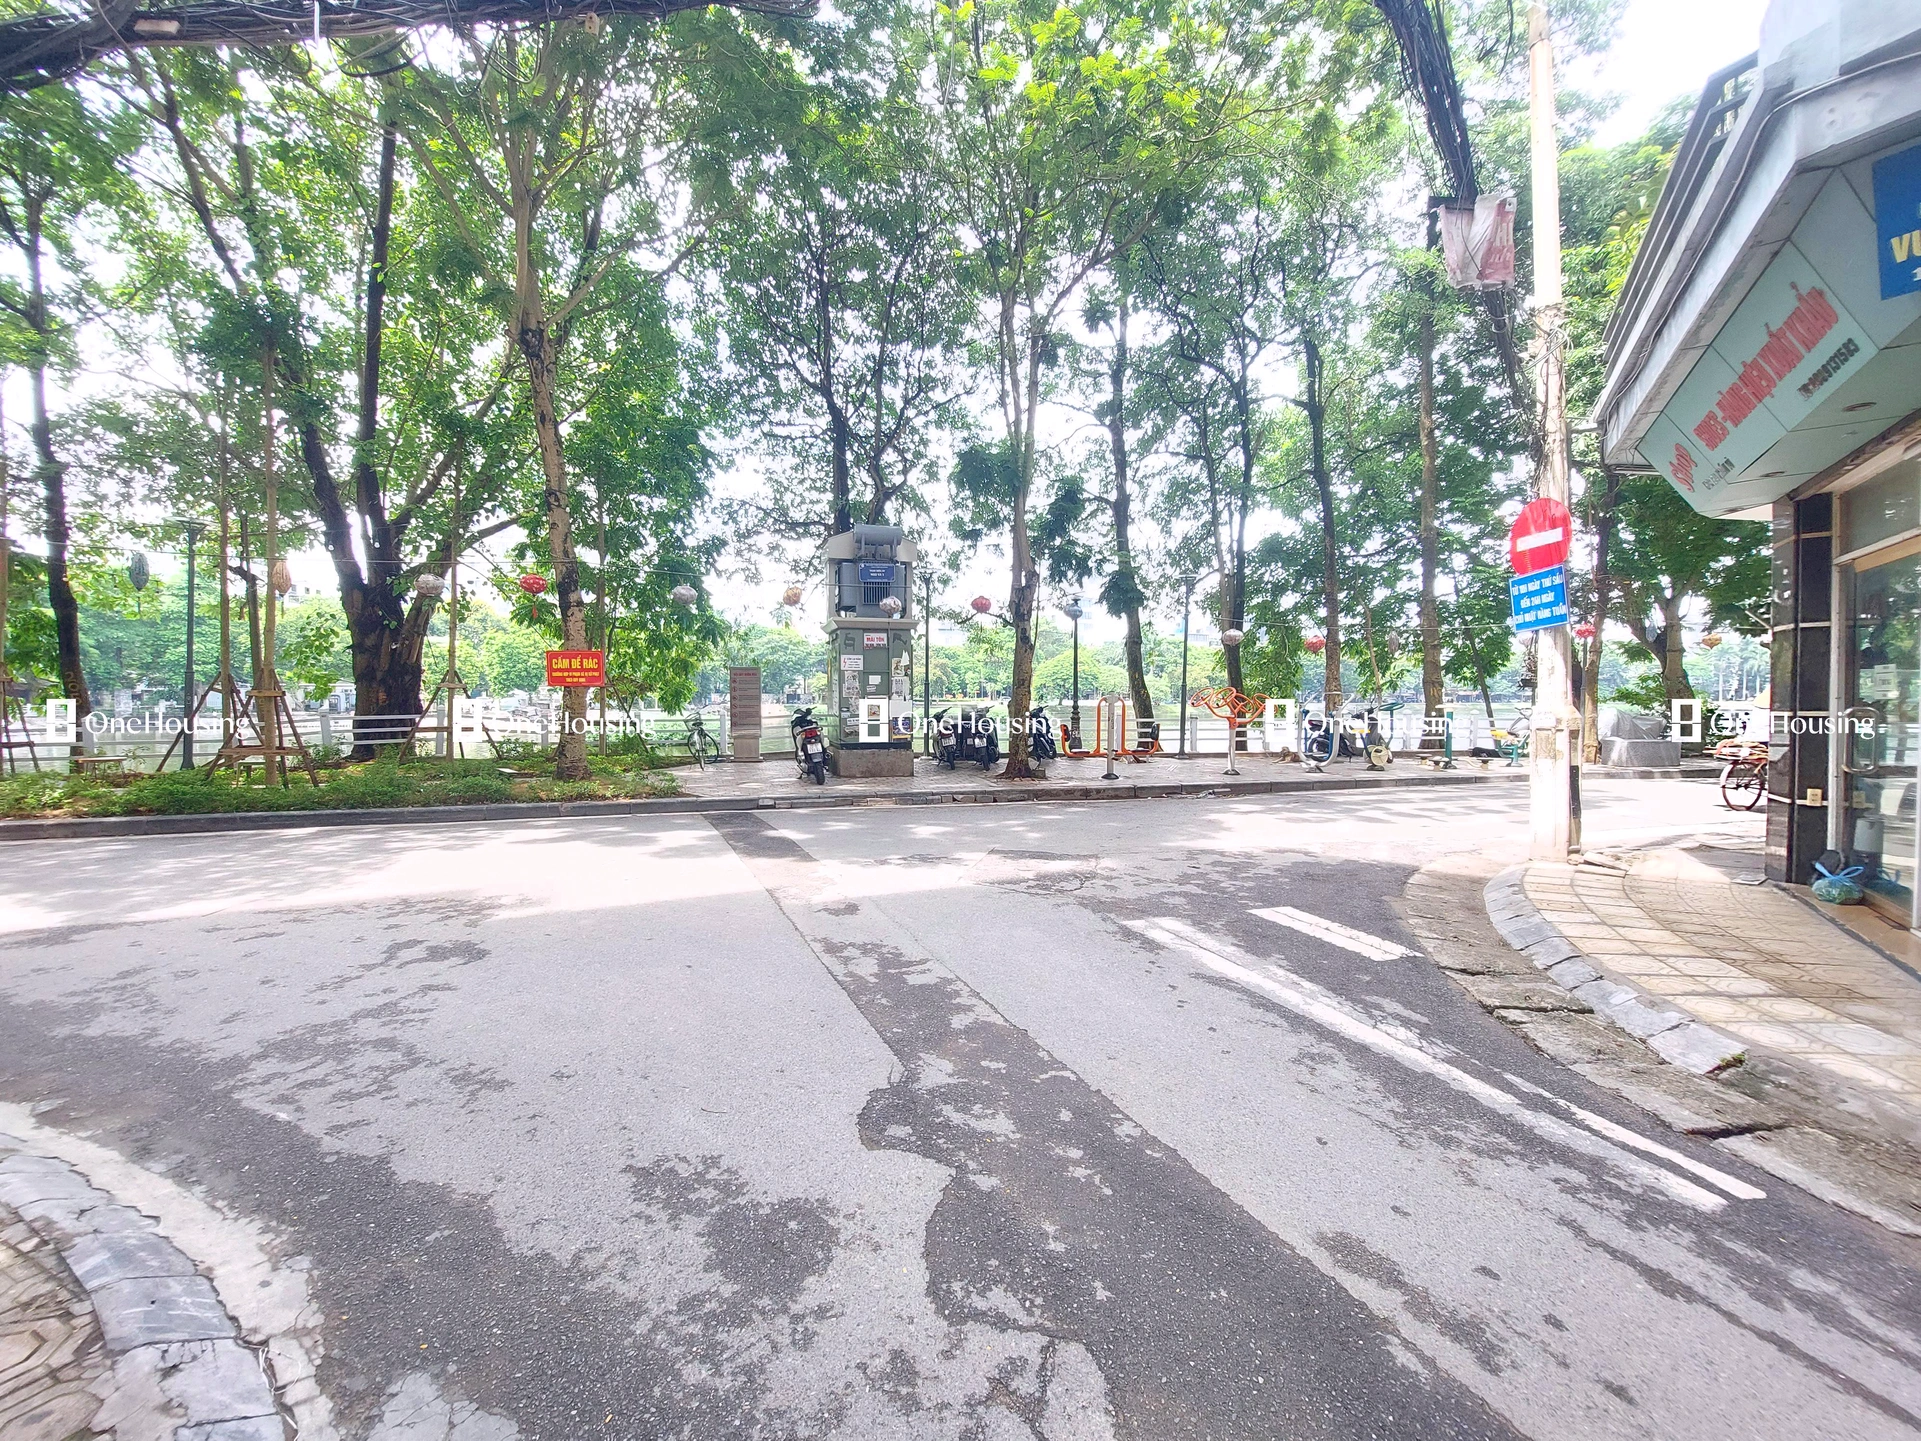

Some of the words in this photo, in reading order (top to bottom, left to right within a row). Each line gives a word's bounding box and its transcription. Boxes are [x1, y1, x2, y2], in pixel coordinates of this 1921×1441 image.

[552, 654, 570, 669] CẤM
[571, 654, 582, 669] ĐỂ
[583, 656, 599, 669] RÁC
